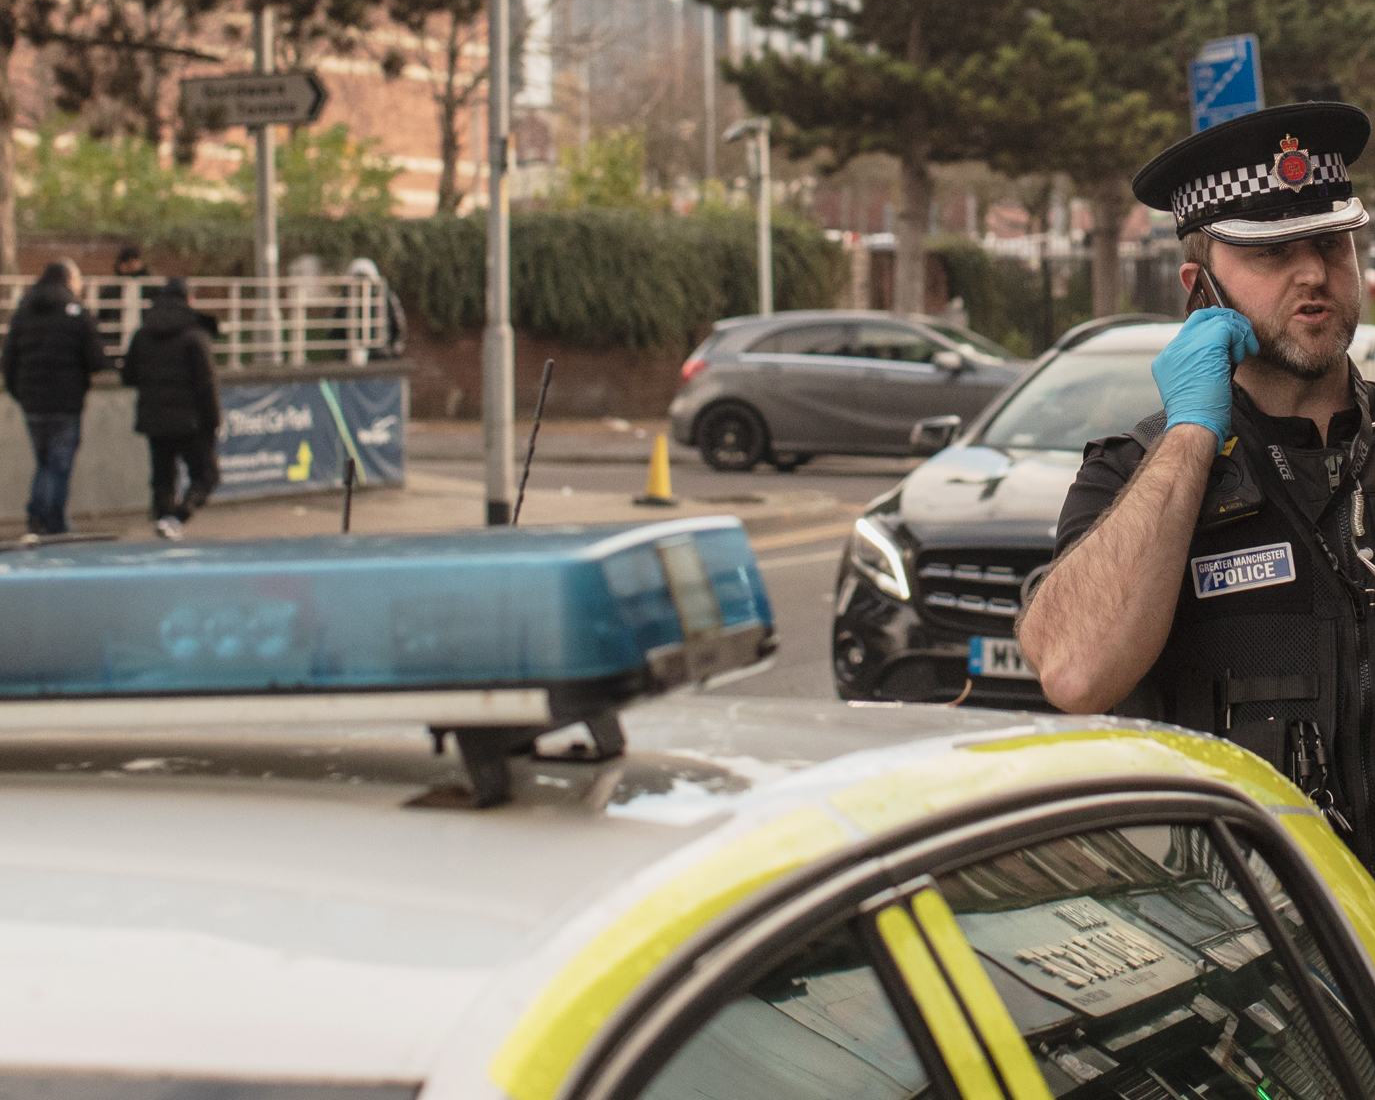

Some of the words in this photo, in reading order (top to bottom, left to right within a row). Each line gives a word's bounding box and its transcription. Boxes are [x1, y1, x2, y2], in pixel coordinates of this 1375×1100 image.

[229, 410, 265, 436] Street
[266, 408, 285, 432] Car
[286, 404, 312, 431] Park
[1268, 445, 1292, 480] POLICE
[1351, 441, 1369, 479] POLICE
[1199, 559, 1233, 573] GREATER
[1233, 549, 1285, 567] MANCHESTER
[1213, 562, 1276, 588] POLICE
